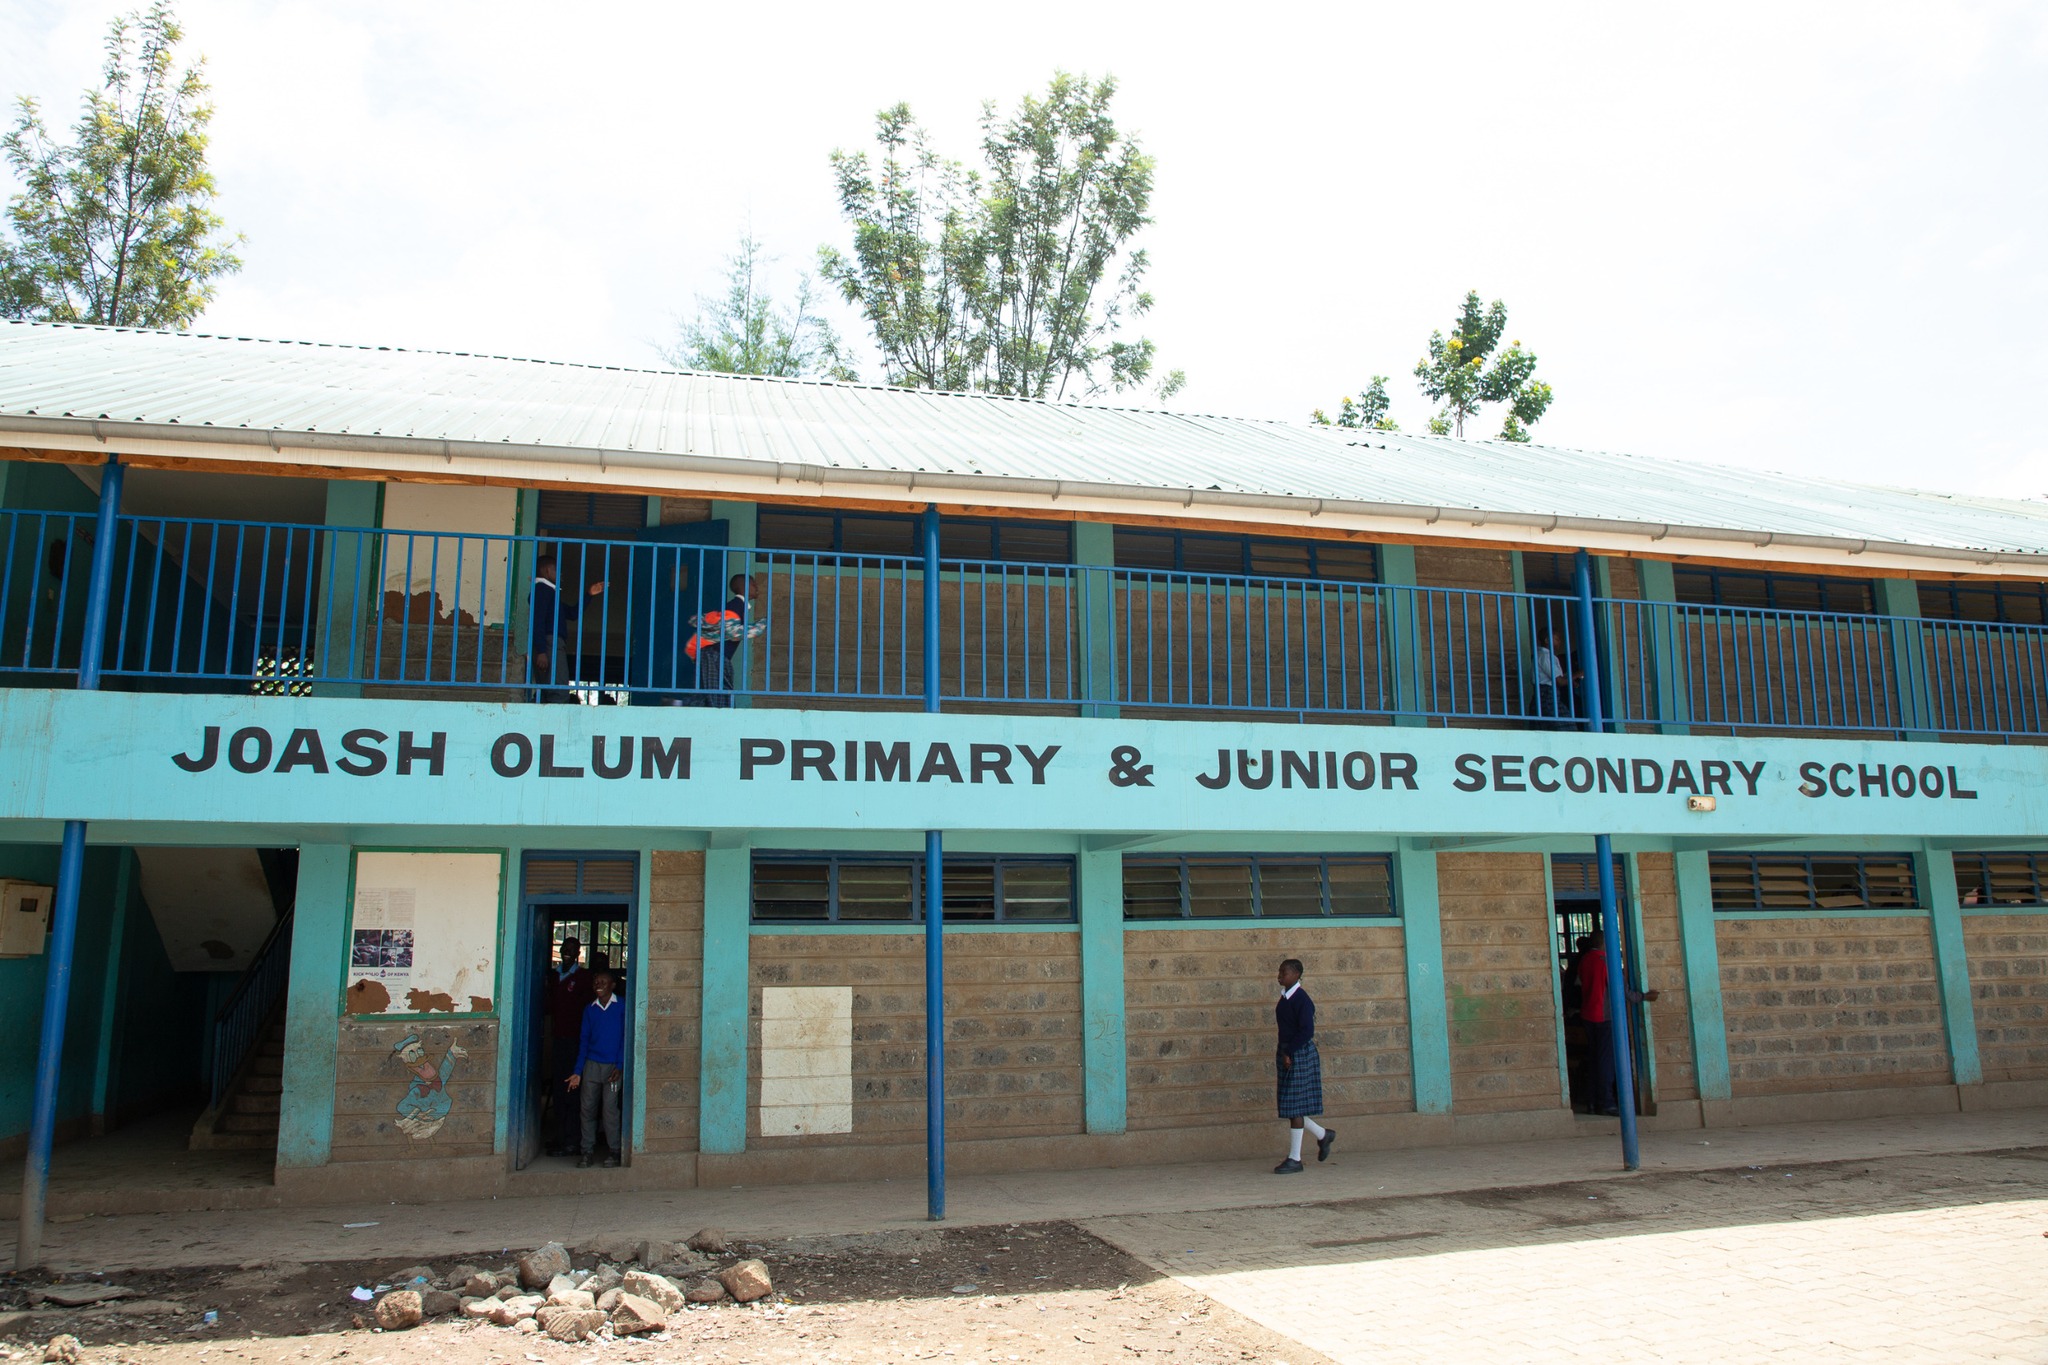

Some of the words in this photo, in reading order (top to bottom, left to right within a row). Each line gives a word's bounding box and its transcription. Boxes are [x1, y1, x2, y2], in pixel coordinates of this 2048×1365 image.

[170, 725, 447, 777] JOASH
[490, 732, 692, 780] OLUM
[739, 738, 1062, 785] PRIMARY
[1108, 745, 1155, 788] &
[1195, 749, 1419, 791] JUNIOR
[1452, 753, 1767, 796] SECONDARY
[1798, 761, 1978, 799] SCHOOL
